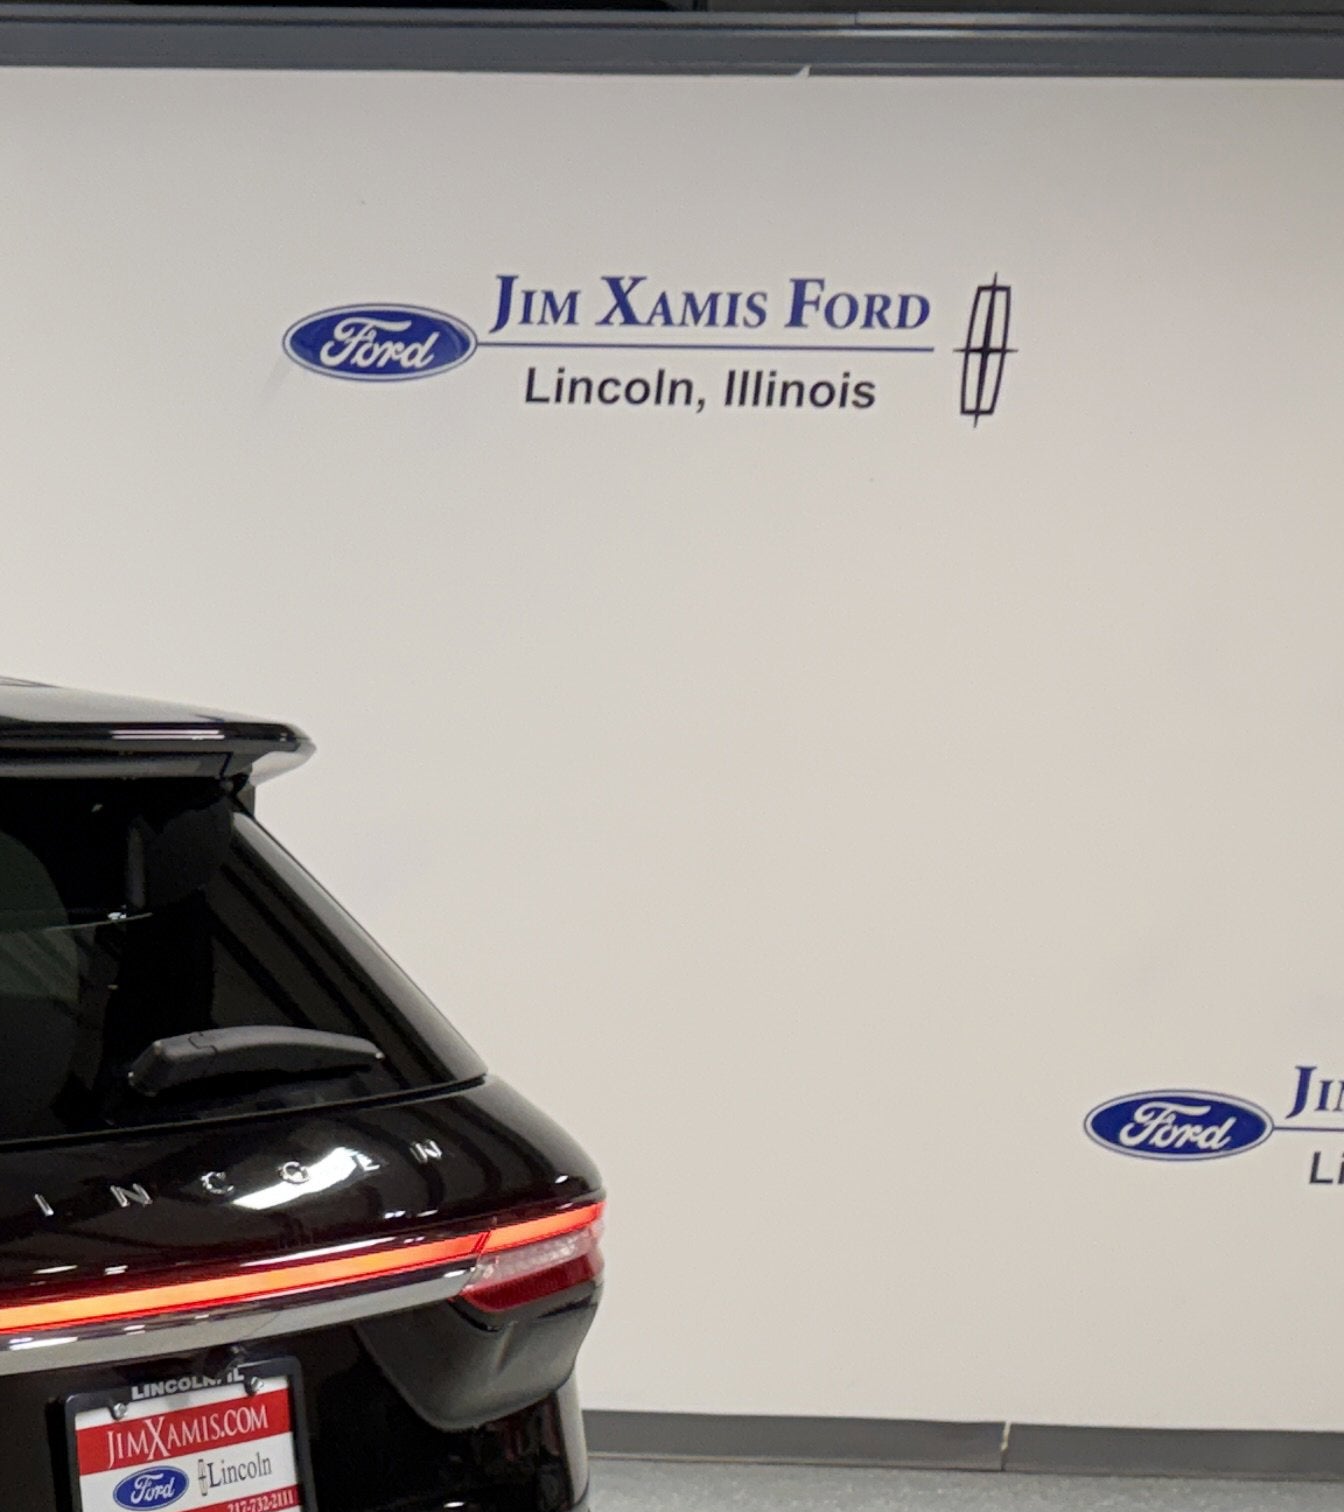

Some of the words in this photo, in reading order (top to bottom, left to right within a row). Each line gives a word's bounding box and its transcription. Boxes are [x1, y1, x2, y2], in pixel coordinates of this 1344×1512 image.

[488, 274, 581, 334] JIM
[594, 275, 769, 329] XAMIS
[784, 277, 931, 331] FORD
[319, 317, 440, 369] Ford
[524, 366, 706, 413] Lincoln,
[724, 369, 877, 410] Illinois
[1118, 1100, 1238, 1150] Ford
[130, 1473, 176, 1505] Ford
[206, 1452, 273, 1489] Lincoln
